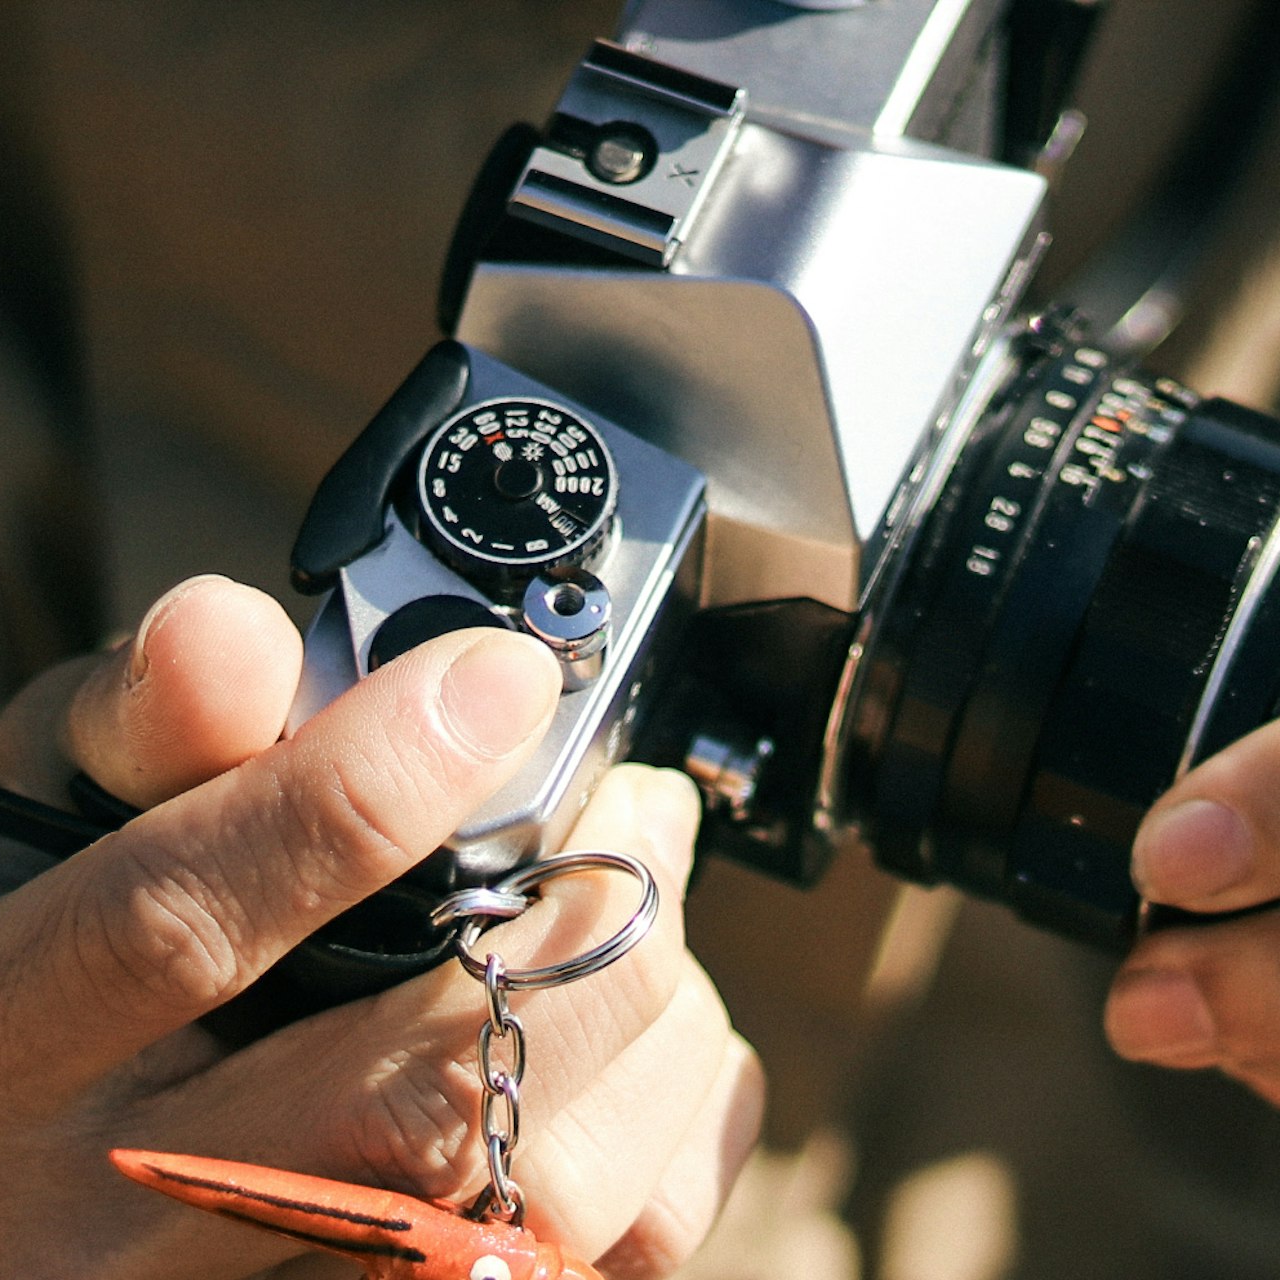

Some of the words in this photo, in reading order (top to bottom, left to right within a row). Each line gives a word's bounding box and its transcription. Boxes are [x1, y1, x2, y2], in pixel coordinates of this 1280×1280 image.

[473, 411, 501, 435] 60
[504, 410, 529, 438] 125
[529, 410, 562, 445] 250
[448, 426, 478, 451] 30
[550, 425, 587, 457] 500
[438, 451, 463, 473] 15
[552, 450, 598, 476] 1000
[432, 478, 446, 498] 8
[555, 476, 604, 496] 2000
[442, 506, 459, 524] 4
[535, 492, 561, 515] ASA
[461, 527, 484, 544] 2
[553, 513, 578, 536] 100
[525, 539, 549, 552] B
